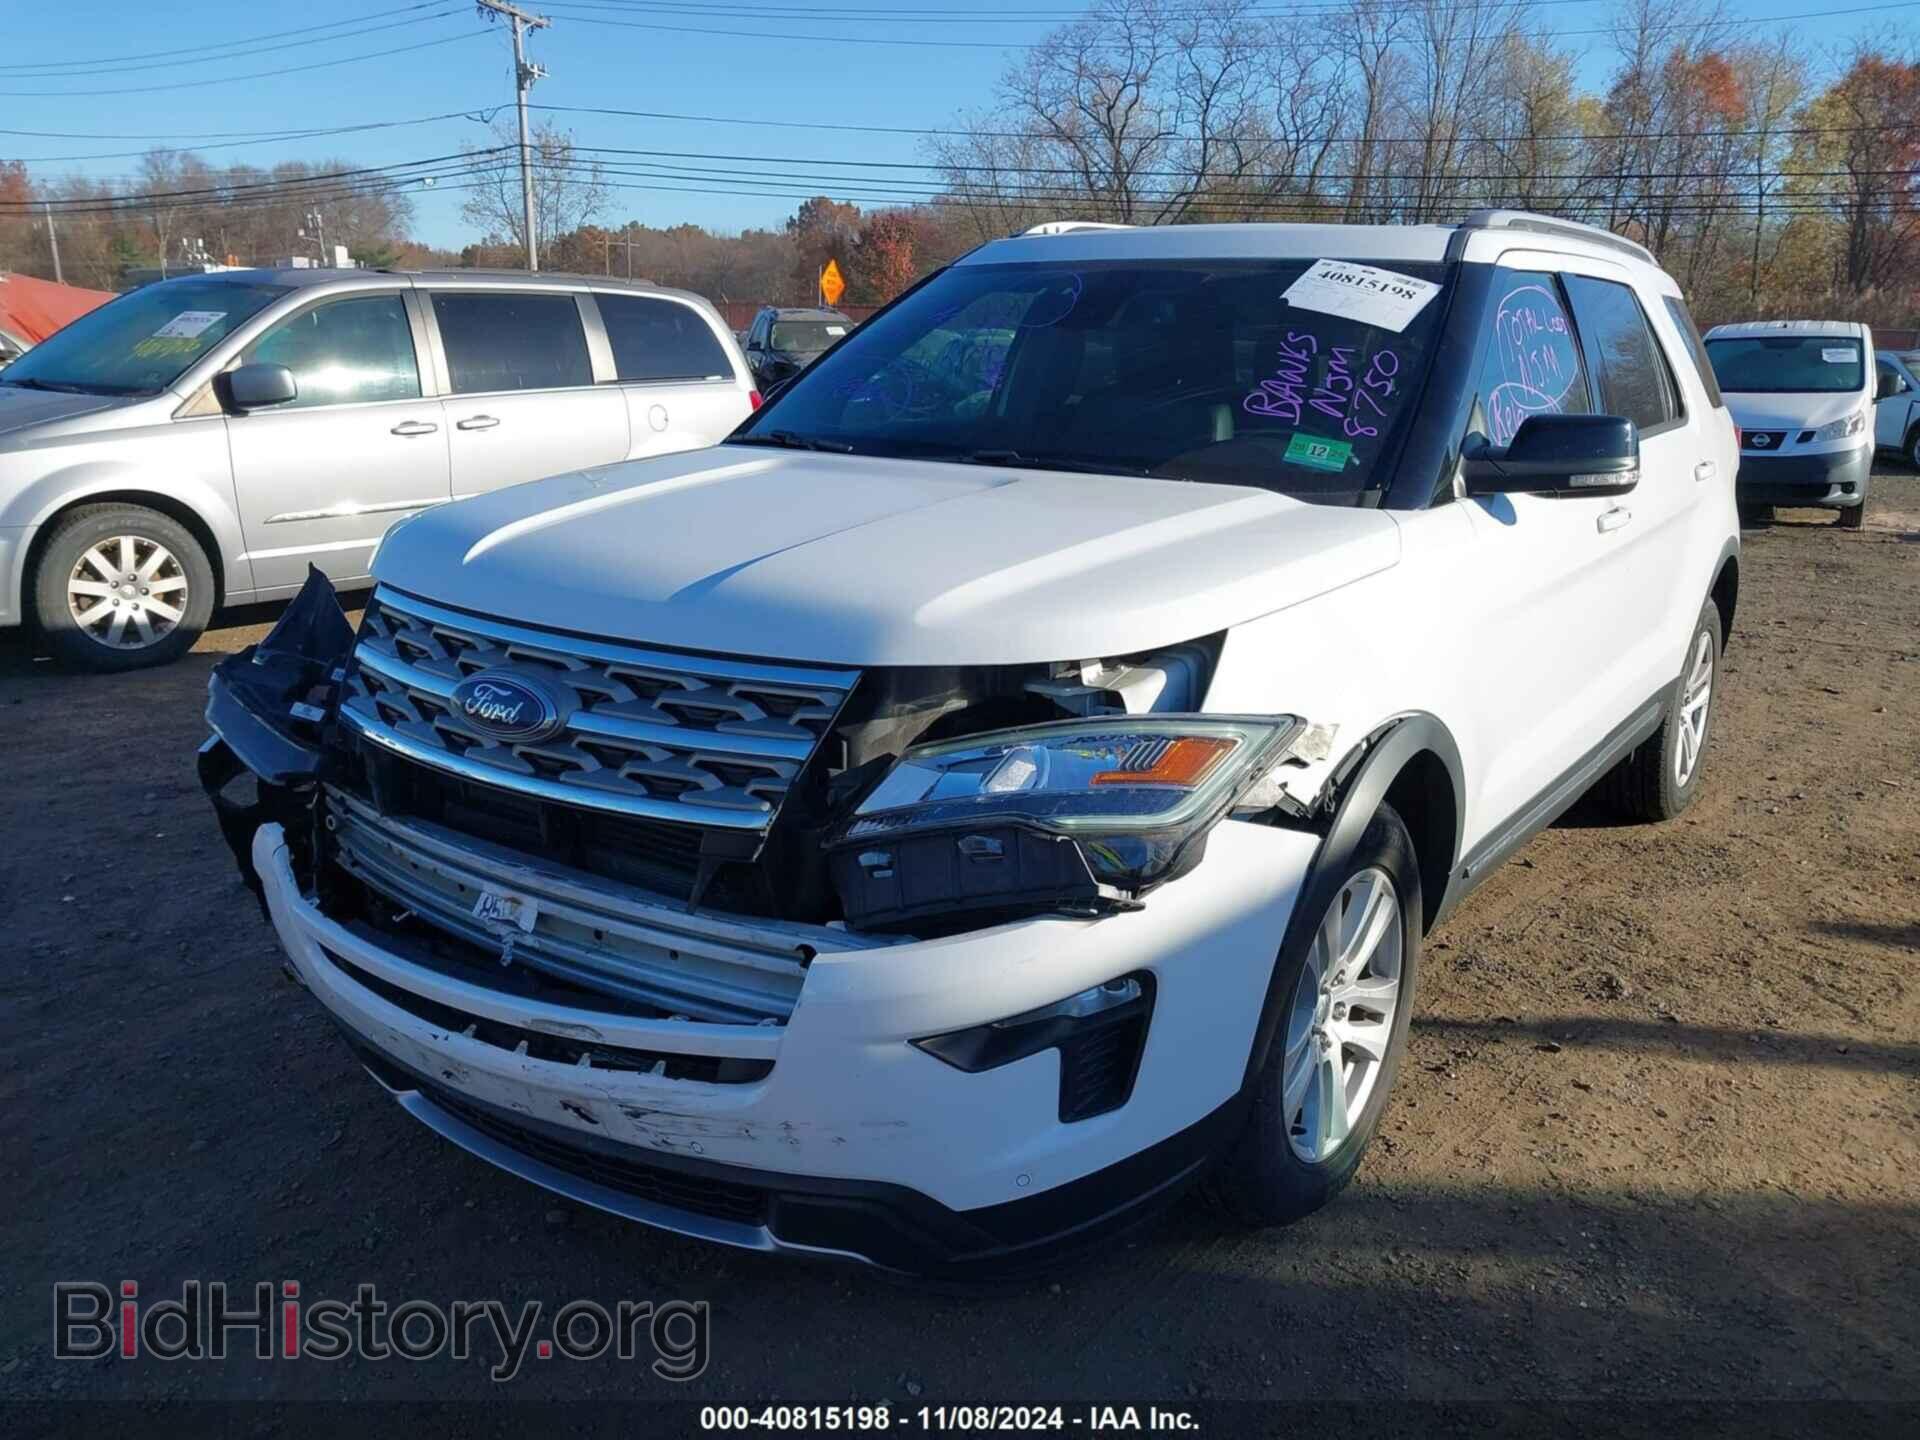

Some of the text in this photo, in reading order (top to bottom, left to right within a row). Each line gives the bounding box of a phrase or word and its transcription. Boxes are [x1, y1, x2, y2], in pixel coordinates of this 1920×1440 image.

[1317, 268, 1417, 301] 40815198
[1243, 330, 1318, 426] BANKS
[1308, 347, 1356, 418] NJM
[1343, 350, 1400, 437] 8750
[1310, 445, 1328, 457] 12
[465, 683, 523, 724] Ford
